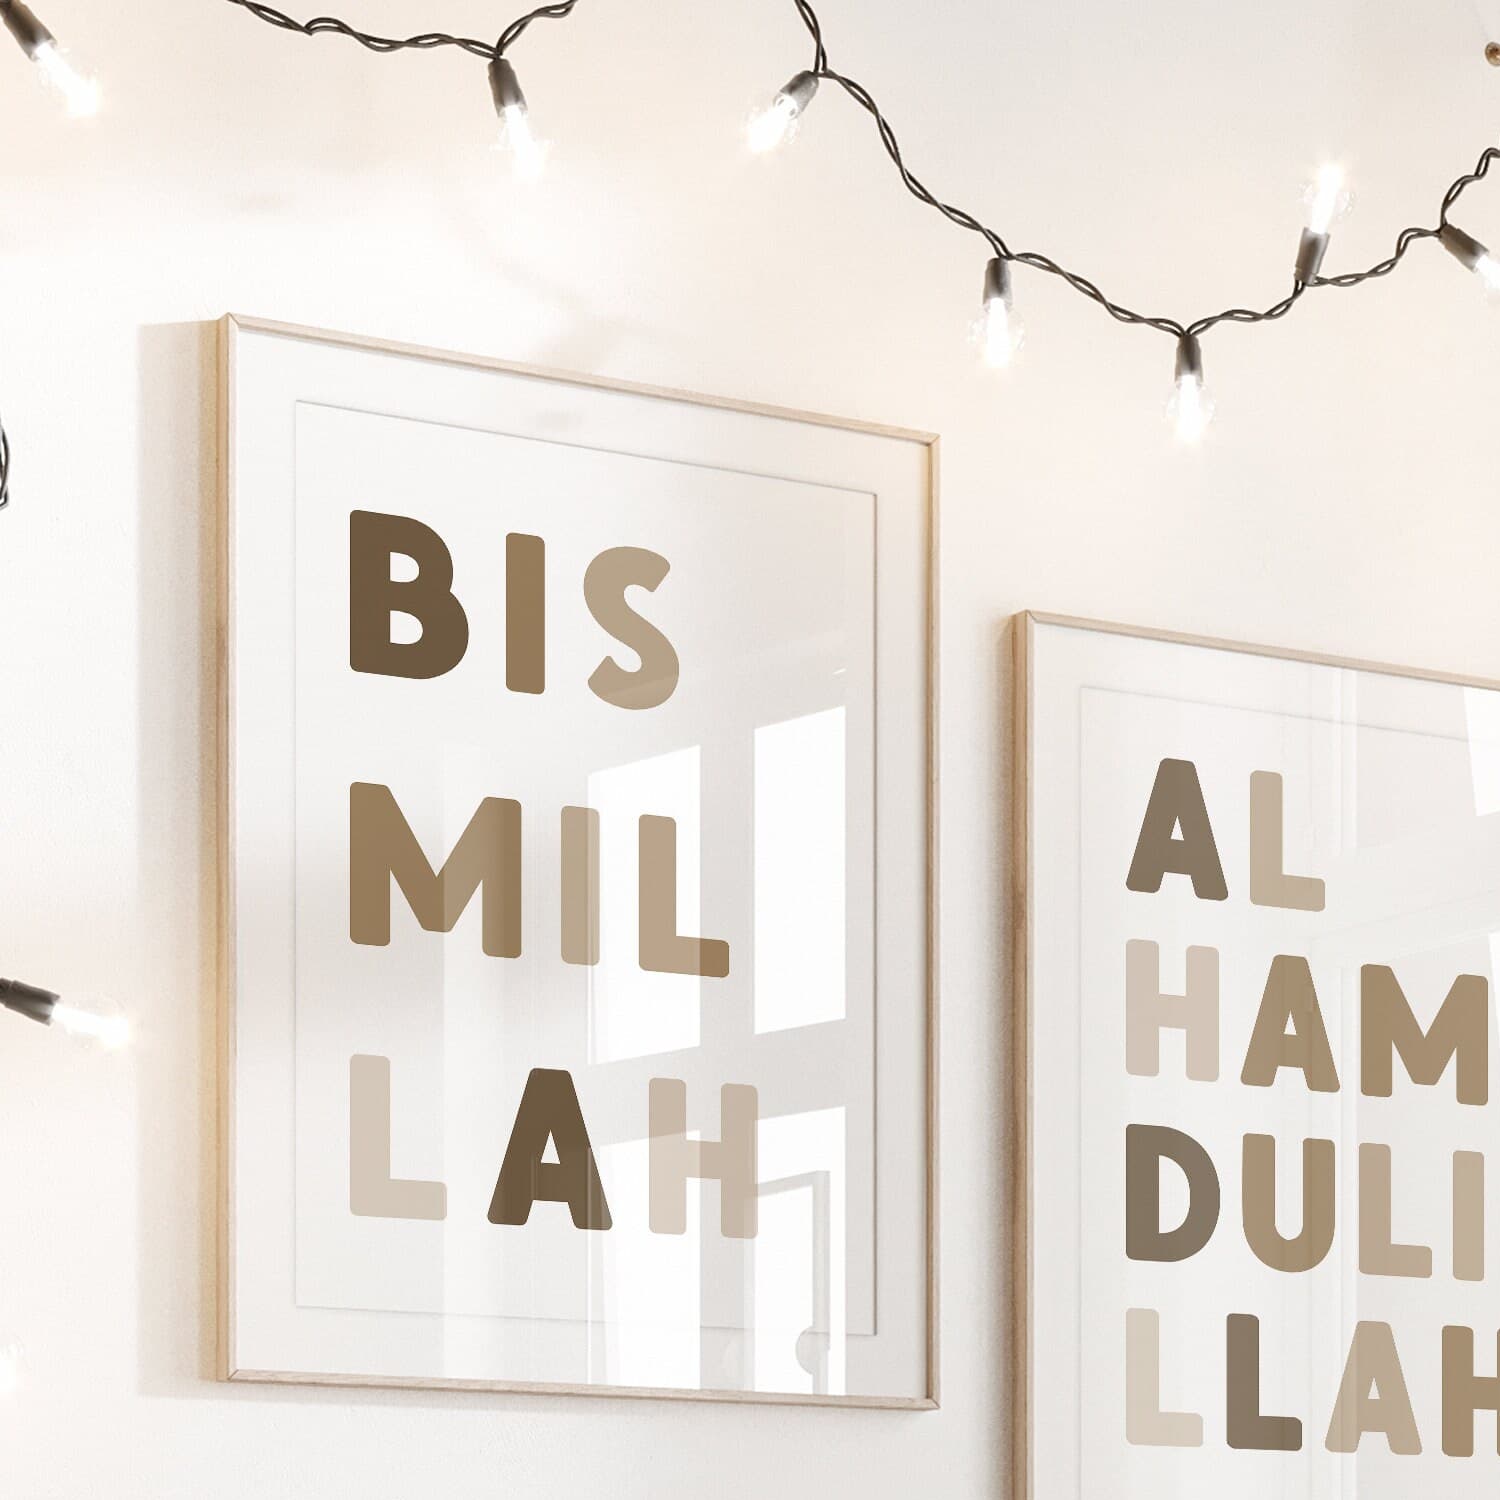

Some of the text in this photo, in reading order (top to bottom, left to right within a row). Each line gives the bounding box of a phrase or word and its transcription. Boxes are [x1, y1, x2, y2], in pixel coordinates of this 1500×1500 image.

[348, 508, 682, 712] BIS
[348, 780, 732, 980] MIL
[1125, 757, 1326, 913] AL
[1125, 936, 1490, 1107] HAM
[348, 1052, 760, 1240] LAH
[1125, 1122, 1487, 1283] DULI
